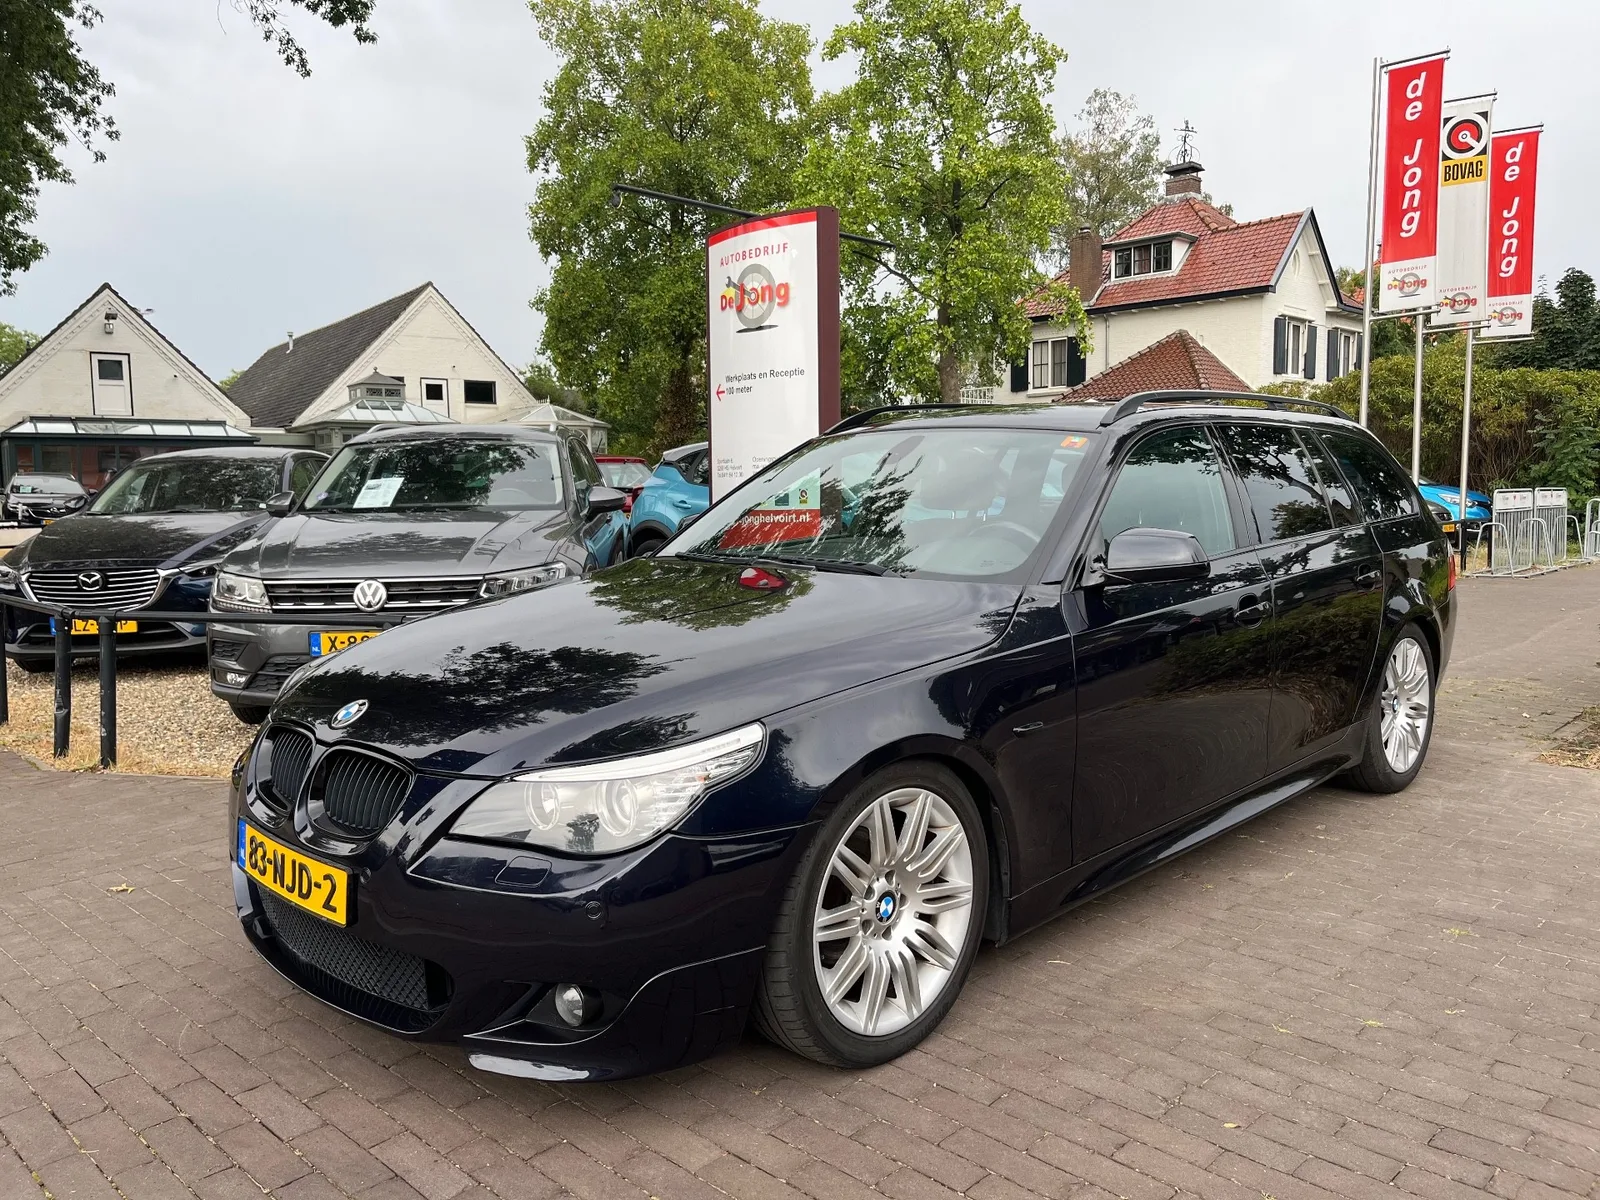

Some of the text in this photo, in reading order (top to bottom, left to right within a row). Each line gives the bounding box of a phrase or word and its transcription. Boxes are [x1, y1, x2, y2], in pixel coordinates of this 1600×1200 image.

[1400, 72, 1426, 238] de Jong
[1443, 160, 1483, 183] BOVAG
[1499, 141, 1524, 278] de Jong
[720, 242, 789, 268] AUTOBEDRIJF
[1388, 265, 1428, 274] AUTOBEDRIJF
[720, 281, 790, 312] De Jong
[725, 367, 805, 384] Werkplaats en Receptie
[725, 385, 753, 395] 100 meter
[248, 835, 338, 914] 83-NJD-2
